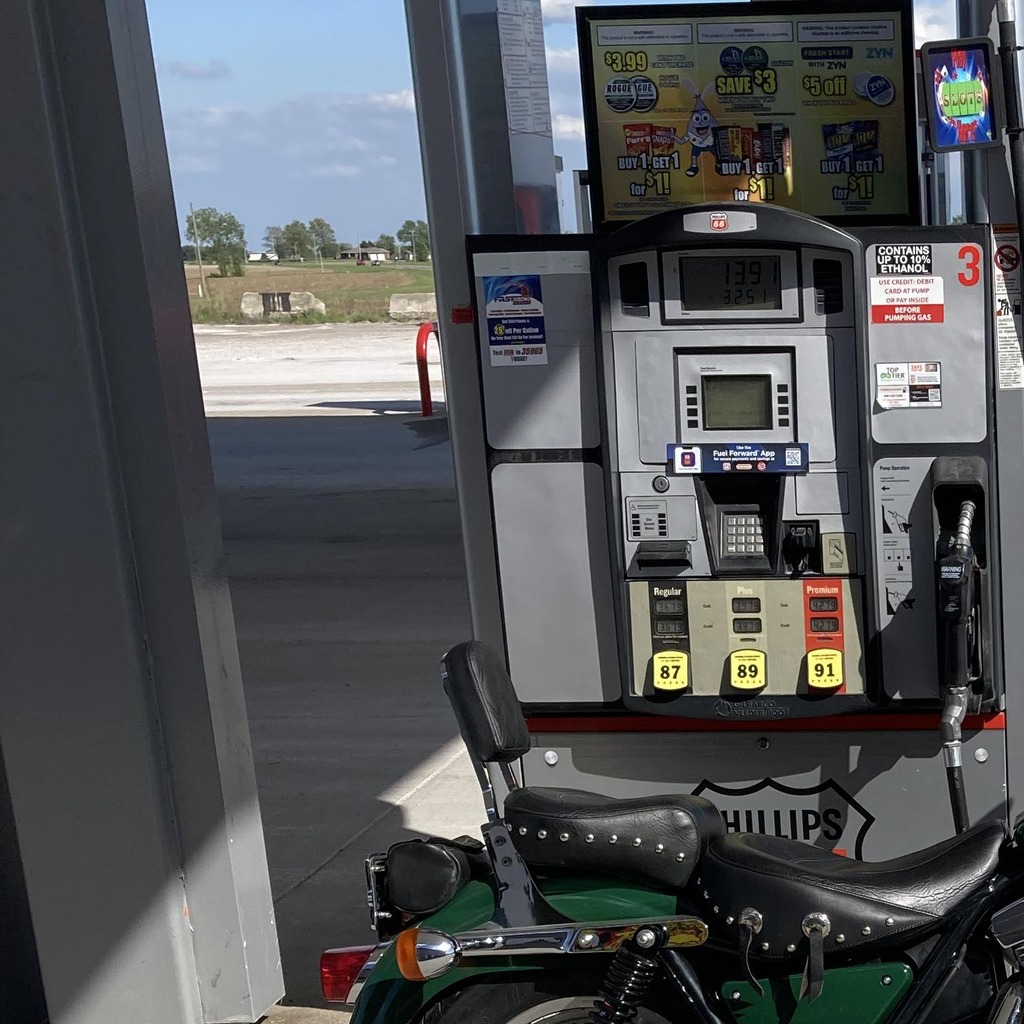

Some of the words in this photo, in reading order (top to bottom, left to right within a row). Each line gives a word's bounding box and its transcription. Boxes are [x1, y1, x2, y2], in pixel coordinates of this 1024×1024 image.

[866, 47, 893, 59] ZYN
[604, 51, 648, 72] $3.99
[827, 61, 847, 70] ZYN
[716, 75, 753, 96] SAVE
[753, 67, 778, 95] $3
[802, 75, 821, 96] $5
[823, 75, 847, 96] off
[607, 84, 632, 94] ROGUE
[942, 90, 982, 107] SLOTS
[617, 156, 638, 170] BUY
[652, 156, 670, 170] GET
[671, 150, 680, 169] 1
[720, 162, 741, 175] BUY
[756, 161, 774, 174] GET
[775, 157, 784, 174] 1
[821, 160, 841, 173] BUY
[856, 160, 874, 173] GET
[875, 154, 884, 173] 1
[630, 182, 646, 196] for
[645, 170, 671, 195] $1!
[733, 188, 749, 201] for
[748, 175, 774, 200] $1!
[832, 186, 849, 200] for
[848, 173, 874, 199] $1!
[713, 220, 725, 229] 66
[878, 246, 930, 255] CONTAINS
[877, 256, 891, 264] UP
[895, 256, 908, 264] TO
[910, 255, 931, 264] 10%
[957, 245, 981, 287] 3
[881, 264, 928, 273] ETHANOL
[894, 306, 921, 314] BEFORE
[884, 314, 917, 322] PUMPING
[917, 313, 931, 321] GAS
[886, 366, 900, 374] TOP
[760, 450, 776, 458] App
[654, 587, 682, 597] Regular
[737, 586, 753, 595] Plus
[806, 586, 839, 594] Premium
[659, 665, 681, 679] 87
[737, 664, 758, 678] 89
[814, 663, 835, 677] 91
[721, 808, 843, 841] HILLIPS
